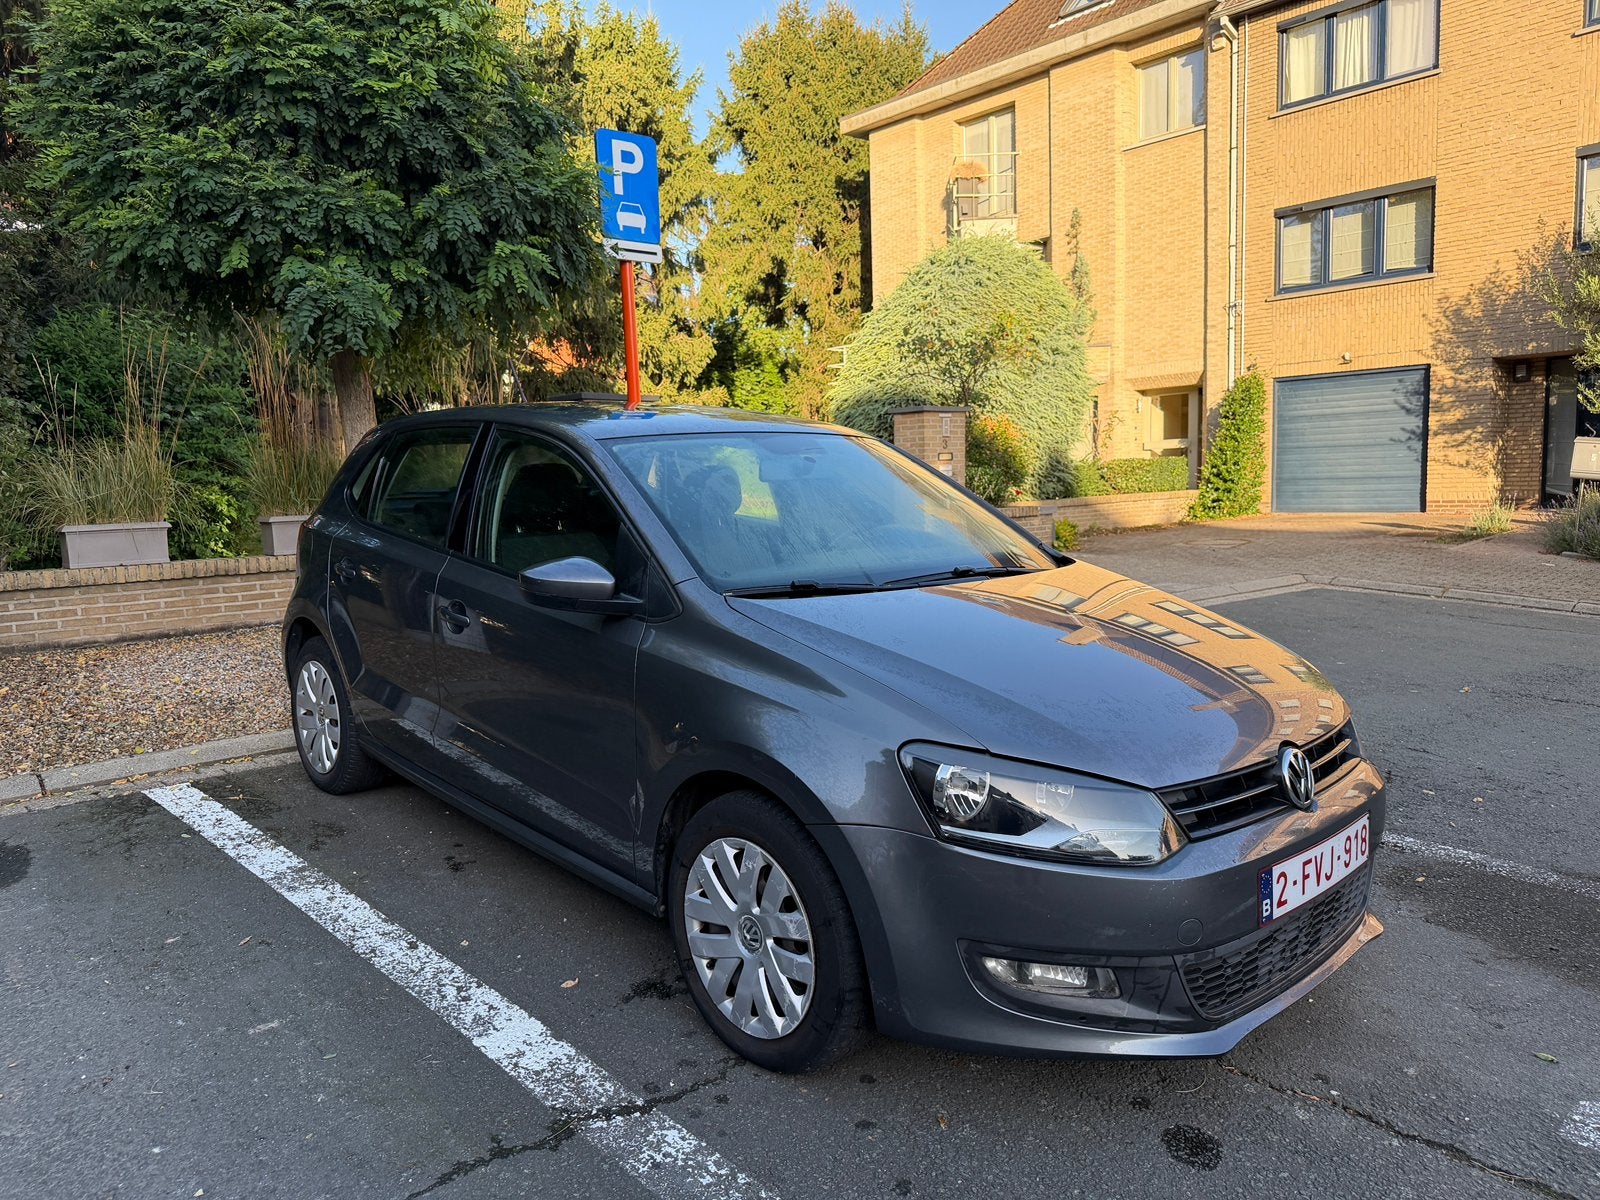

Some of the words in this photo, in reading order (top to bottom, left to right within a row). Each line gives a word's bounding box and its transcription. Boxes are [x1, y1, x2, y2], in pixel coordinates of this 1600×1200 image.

[611, 138, 644, 196] P
[942, 438, 948, 450] 3
[1276, 824, 1368, 909] 2-FVJ-918
[1262, 898, 1271, 918] B
